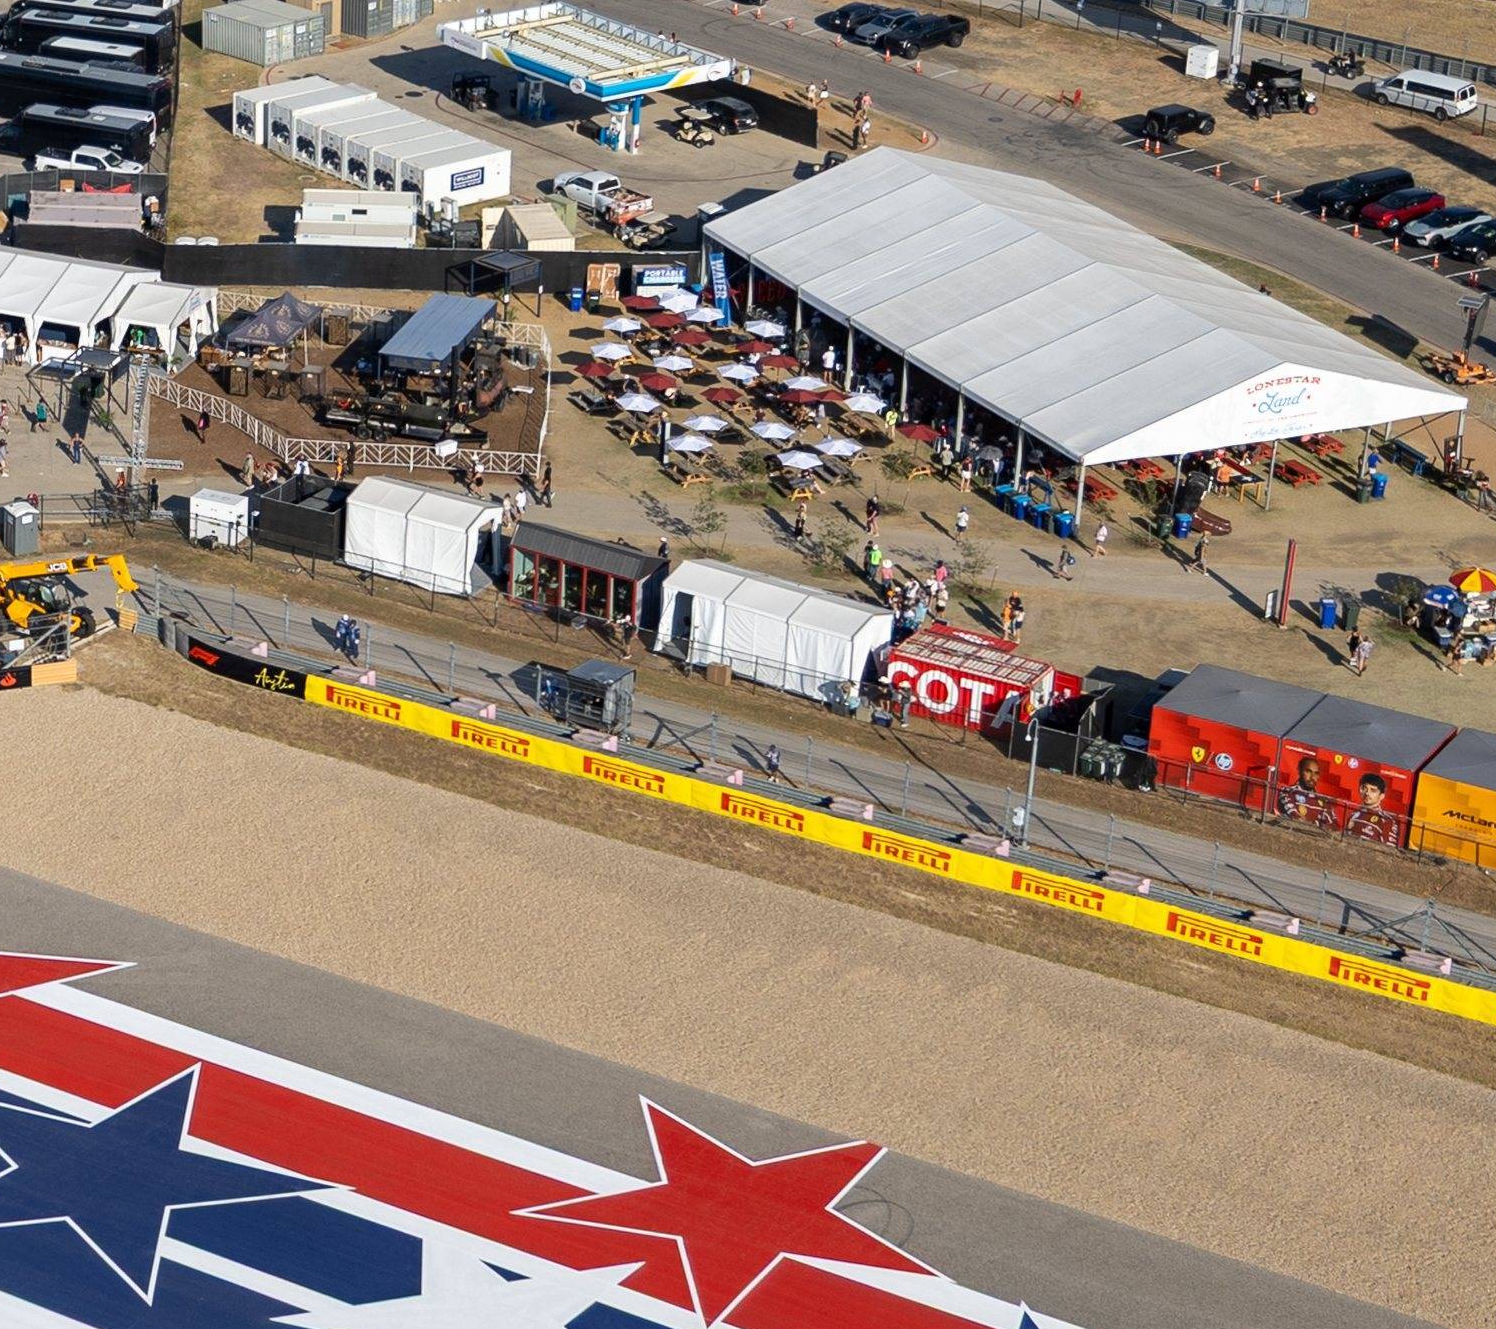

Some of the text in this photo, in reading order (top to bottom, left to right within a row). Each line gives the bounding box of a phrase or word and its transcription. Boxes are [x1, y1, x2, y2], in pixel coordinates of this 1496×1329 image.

[644, 269, 684, 277] PORTABLE
[711, 259, 727, 299] WATER
[1246, 375, 1321, 395] LONESTAR
[1258, 387, 1308, 414] Land
[48, 562, 67, 572] JCB
[325, 684, 402, 721] PIRELLI
[451, 720, 530, 757] PIRELLI
[583, 754, 666, 794] PIRELLI
[721, 791, 806, 832] PIRELLI
[862, 830, 952, 873] PIRELLI
[1011, 870, 1105, 912] PIRELLI
[1166, 911, 1264, 956] PIRELLI
[1329, 956, 1432, 1001] PIRELLI
